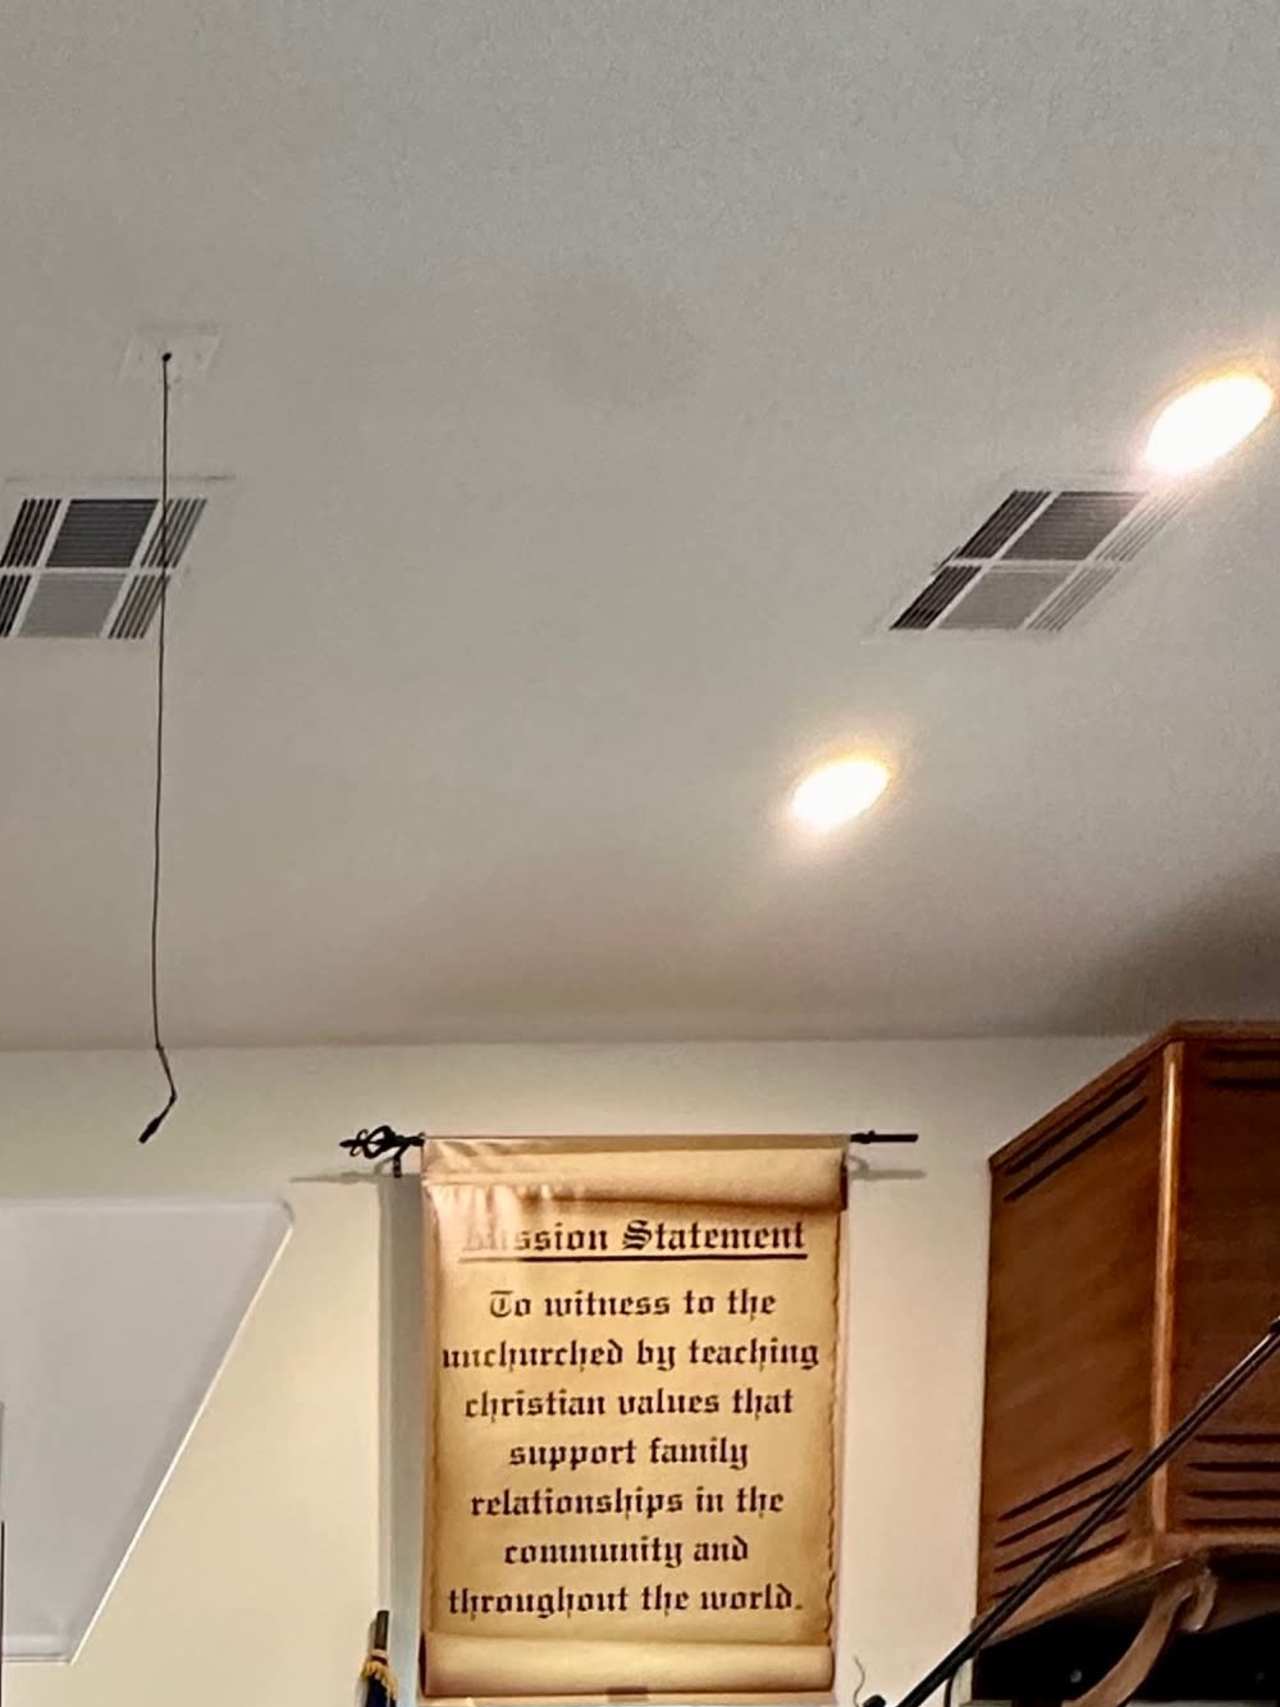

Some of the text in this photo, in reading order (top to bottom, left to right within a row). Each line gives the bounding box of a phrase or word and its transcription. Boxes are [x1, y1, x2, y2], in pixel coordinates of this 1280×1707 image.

[621, 1219, 805, 1251] Statement
[489, 1288, 777, 1322] To witness to the
[442, 1337, 820, 1373] unchurched by teaching
[464, 1386, 794, 1424] christian values that
[509, 1436, 749, 1472] support family
[470, 1485, 784, 1520] relationships in the
[504, 1534, 749, 1568] community and
[448, 1583, 803, 1621] throughout the world.
